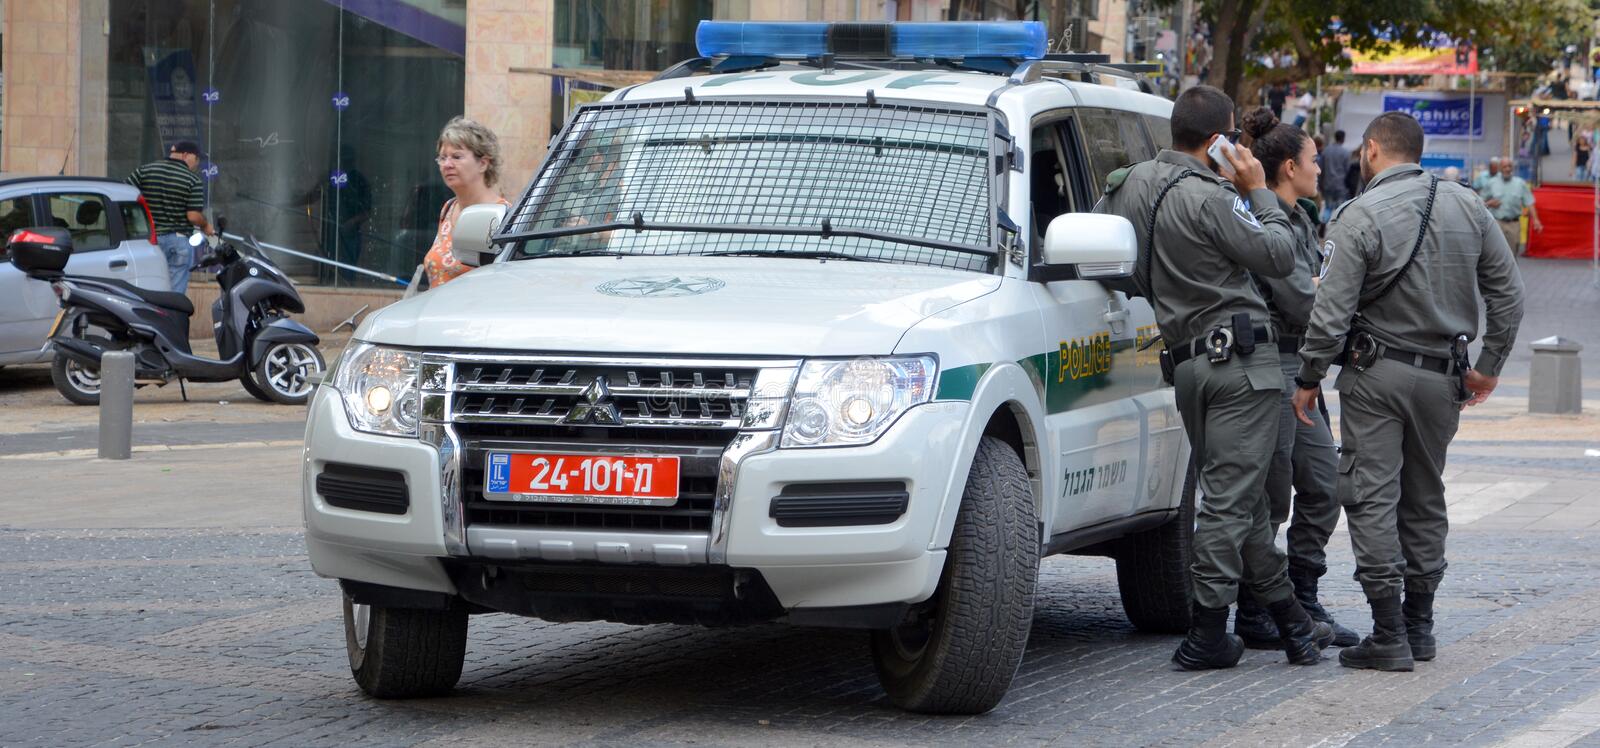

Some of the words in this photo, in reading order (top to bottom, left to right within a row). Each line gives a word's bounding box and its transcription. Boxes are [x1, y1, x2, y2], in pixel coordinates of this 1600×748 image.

[1058, 330, 1111, 383] POLICE
[494, 465, 505, 480] IL
[1062, 467, 1096, 498] הגבול
[1098, 460, 1127, 489] משמר
